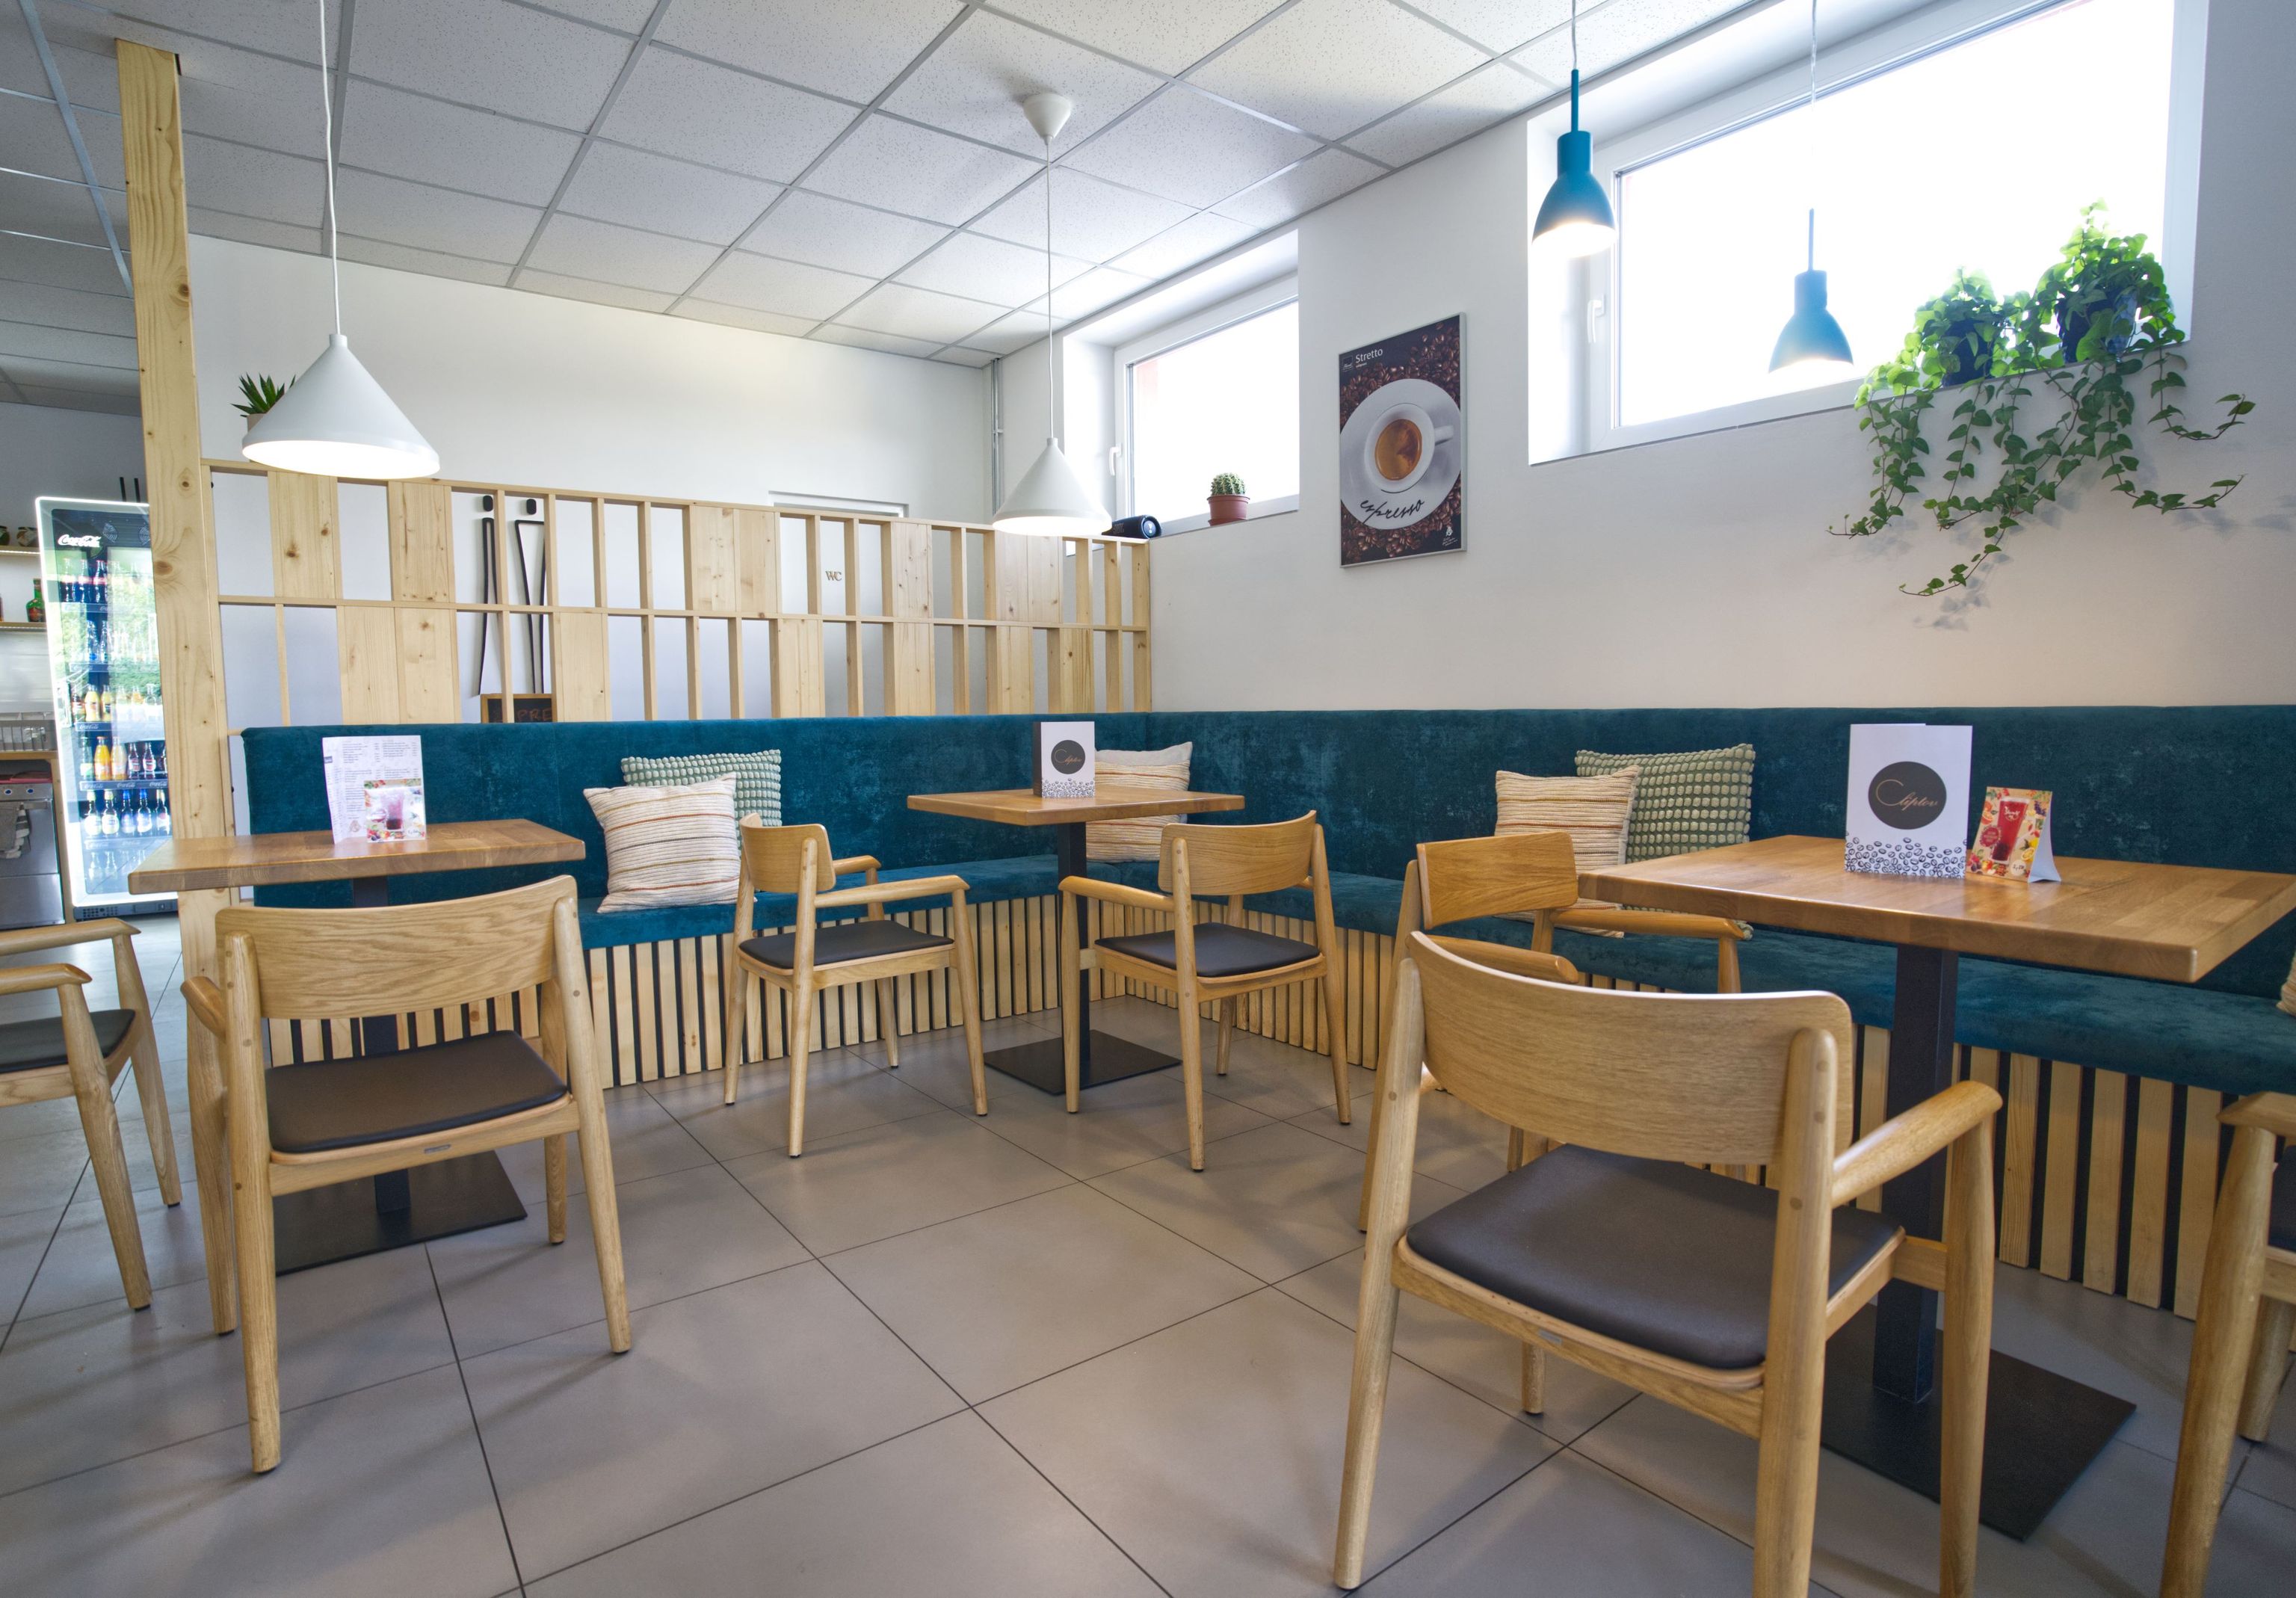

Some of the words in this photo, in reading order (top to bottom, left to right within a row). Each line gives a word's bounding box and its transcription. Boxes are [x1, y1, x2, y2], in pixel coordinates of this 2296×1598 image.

[1355, 349, 1383, 363] Stretto
[1360, 499, 1425, 524] espresso
[825, 570, 842, 581] WC
[1876, 779, 1938, 811] Clapton
